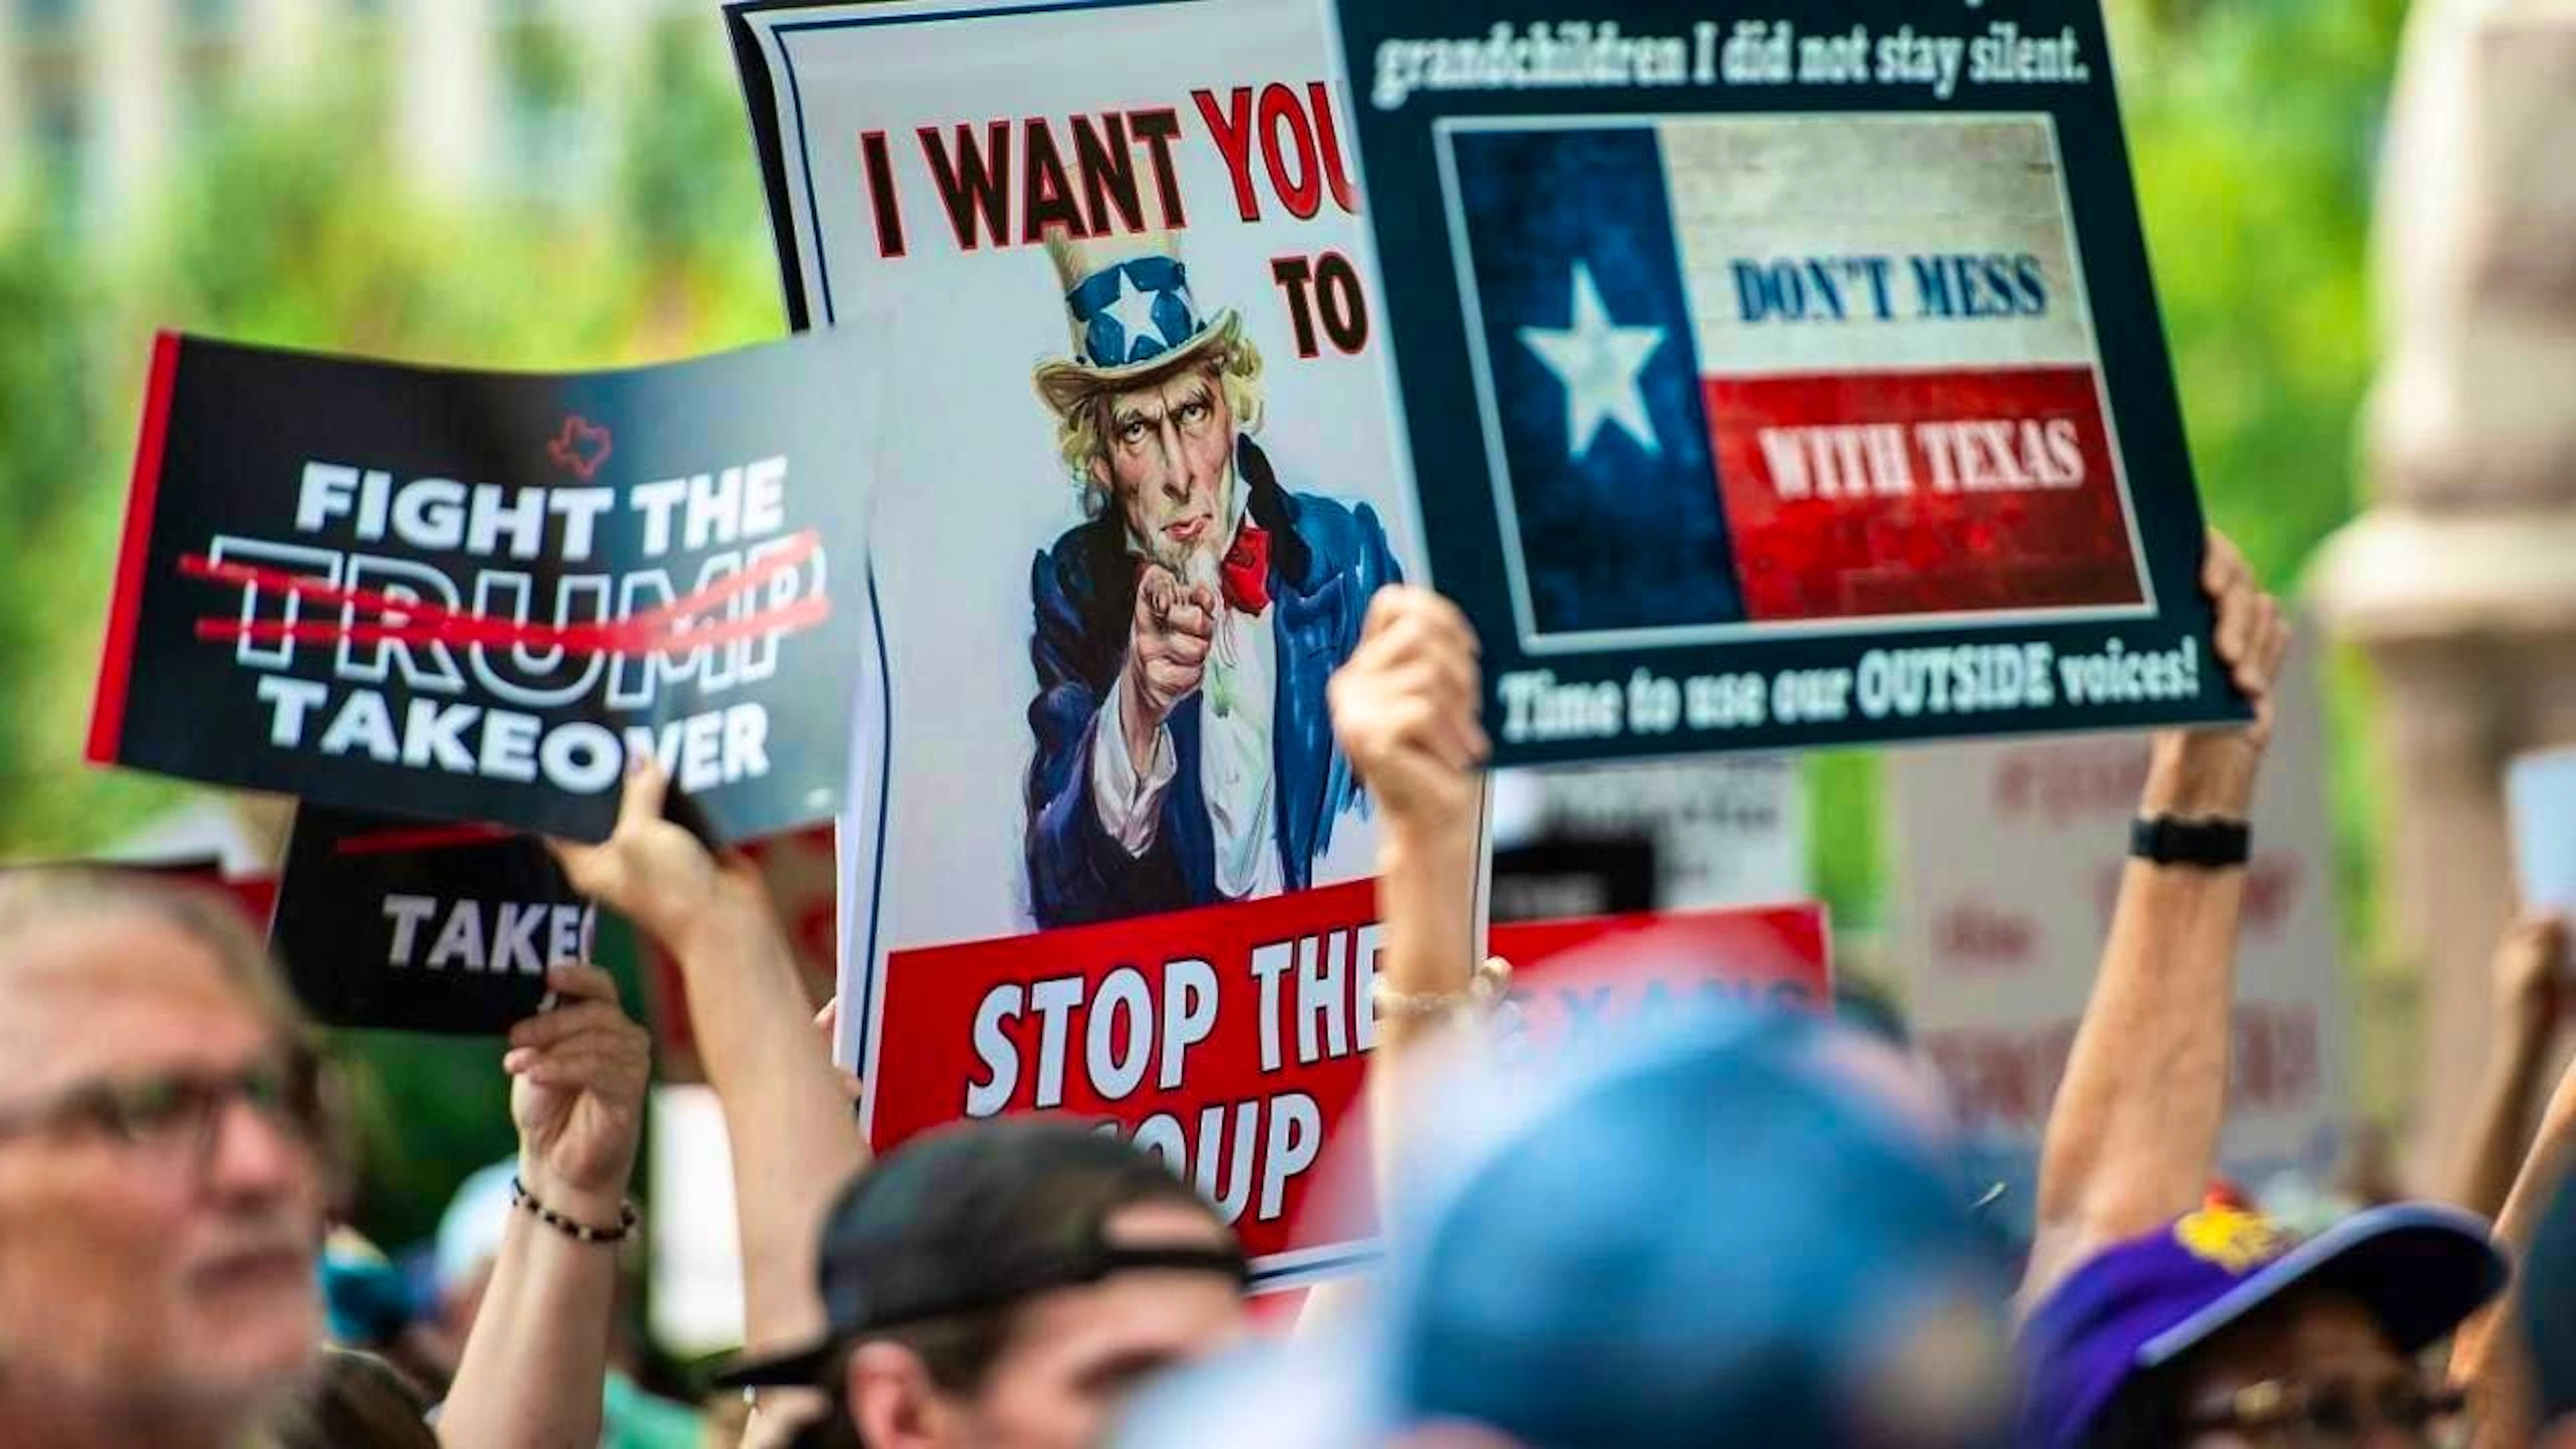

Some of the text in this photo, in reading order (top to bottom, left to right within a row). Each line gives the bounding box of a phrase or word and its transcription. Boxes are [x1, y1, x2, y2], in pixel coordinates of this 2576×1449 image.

[1372, 20, 2090, 109] grandchildren I did not stay silent.
[860, 129, 906, 258] I
[916, 107, 1186, 250] WANT
[1271, 251, 1369, 360] TO
[1729, 254, 2047, 322] DON'T MESS
[295, 457, 788, 558] FIGHT THE
[1757, 418, 2084, 500] WITH TEXAS
[207, 534, 826, 710] TRUMP
[258, 678, 769, 794] TAKEOVER
[1498, 635, 2200, 742] Time to use our OUTSIDE voices!
[965, 920, 1386, 1119] STOP THE
